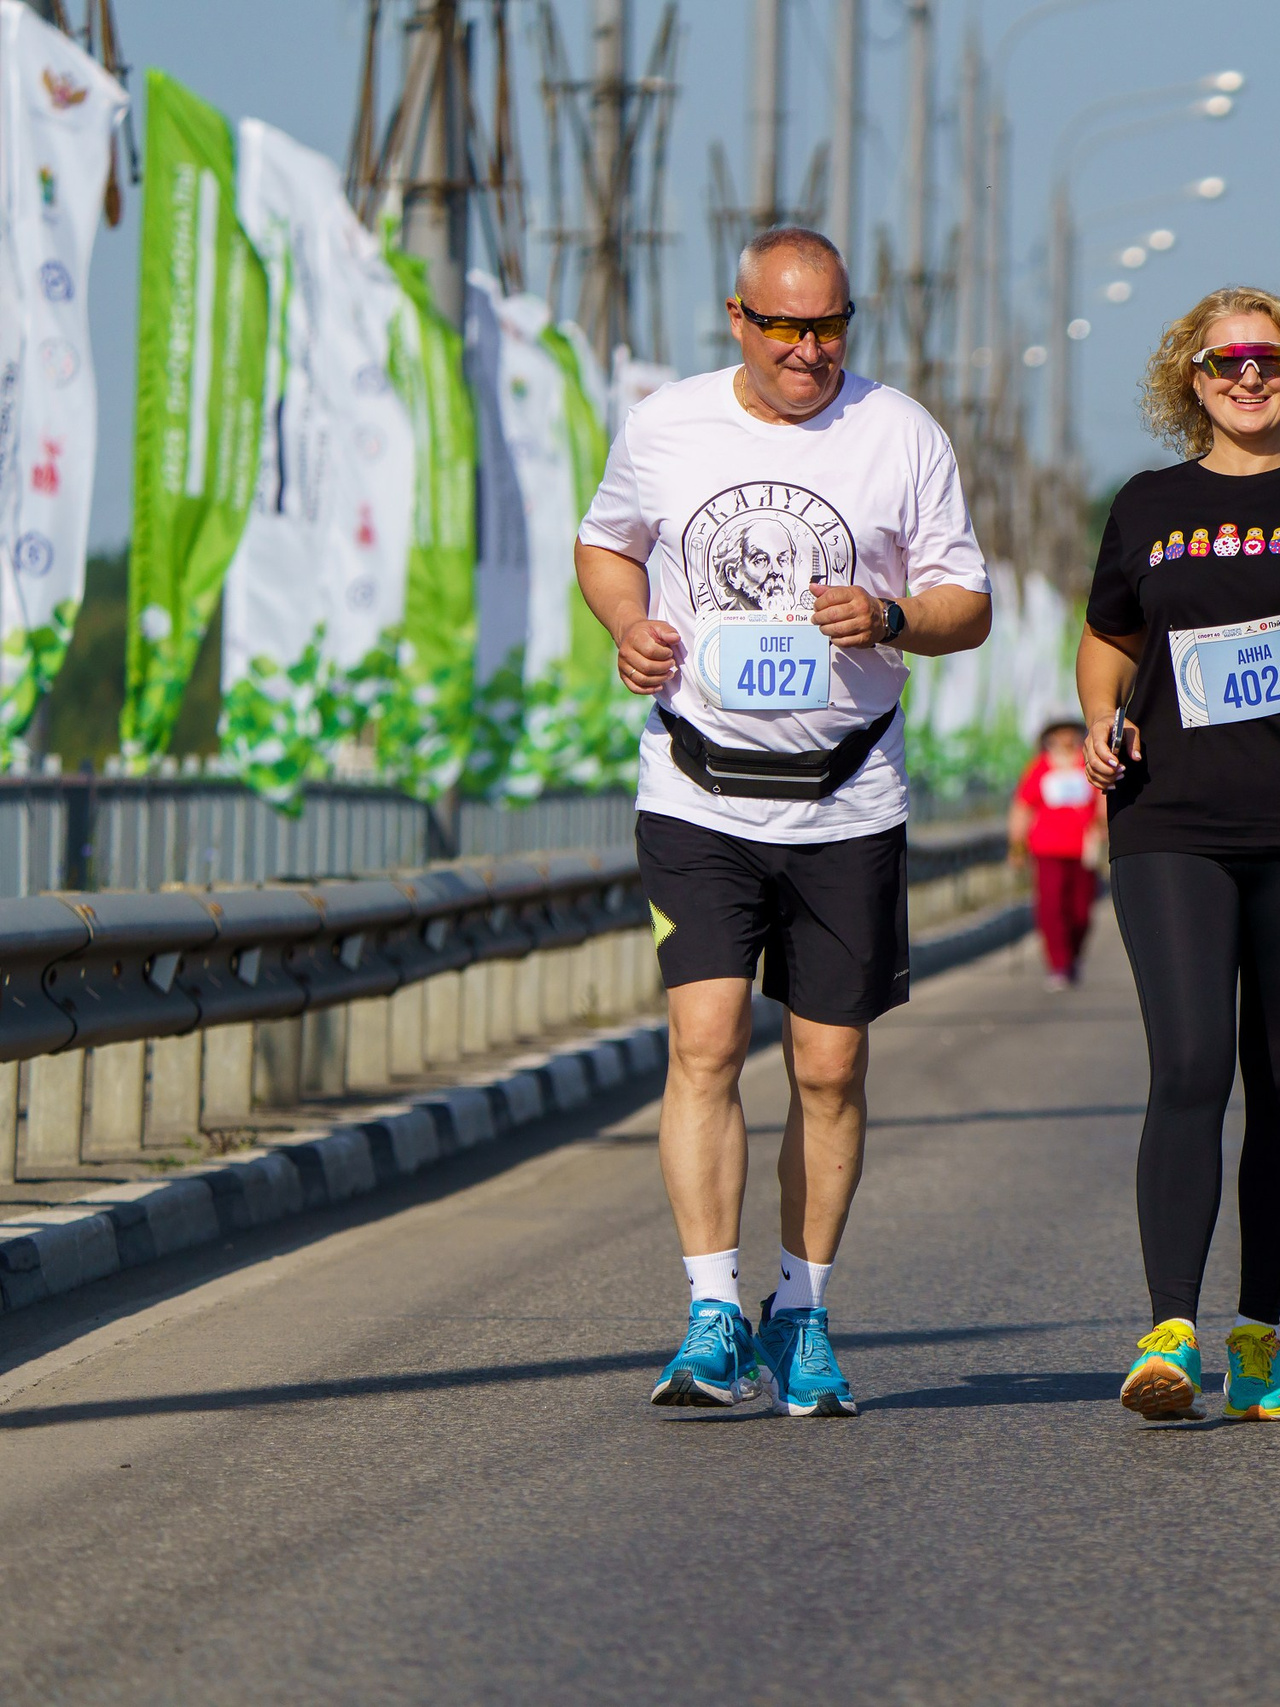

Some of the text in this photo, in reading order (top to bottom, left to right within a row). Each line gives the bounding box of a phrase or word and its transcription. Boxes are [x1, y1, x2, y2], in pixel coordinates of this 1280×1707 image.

[703, 485, 841, 537] КАЛУГА
[795, 614, 808, 622] Пэй
[1268, 620, 1280, 629] Пэй
[760, 636, 794, 653] ОЛЕГ
[1237, 644, 1273, 665] АННА
[737, 659, 817, 697] 4027
